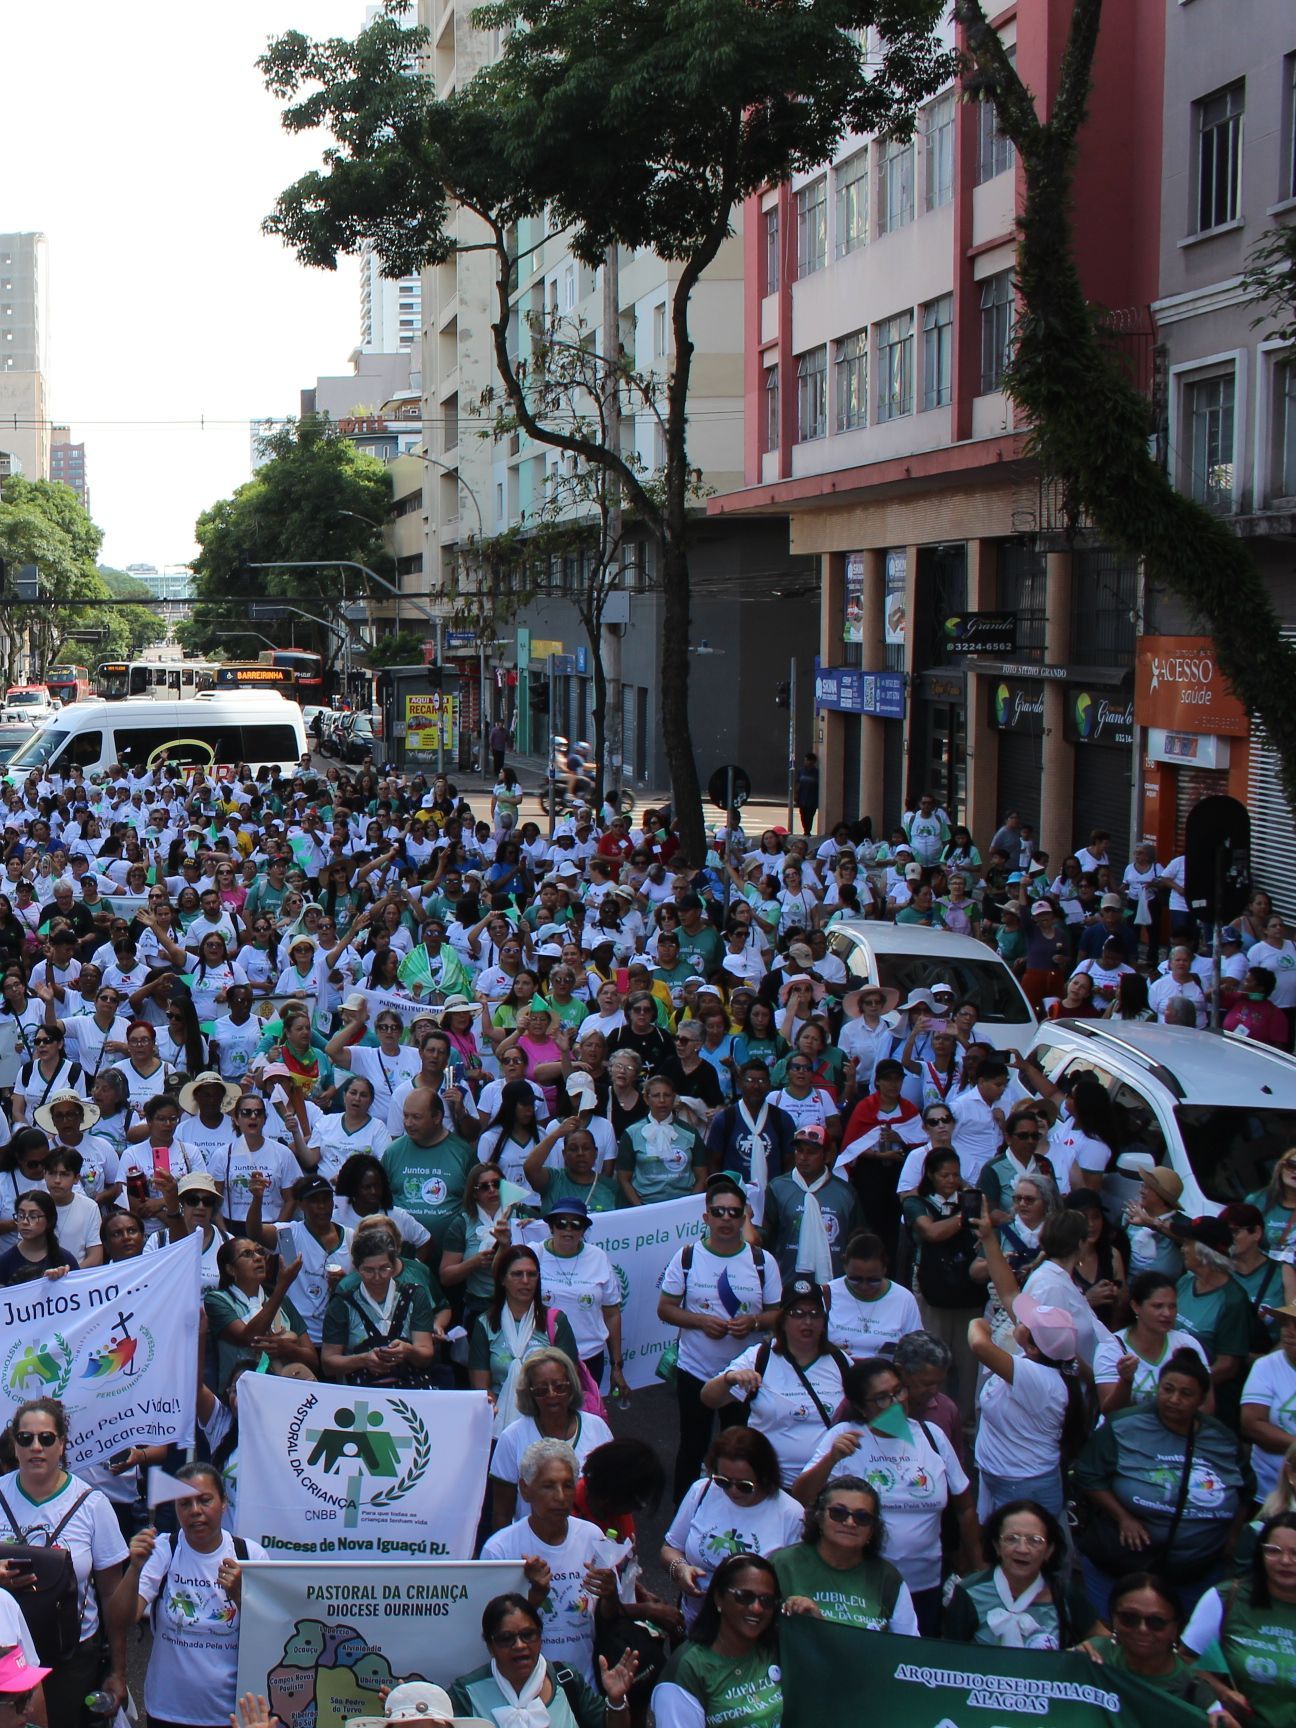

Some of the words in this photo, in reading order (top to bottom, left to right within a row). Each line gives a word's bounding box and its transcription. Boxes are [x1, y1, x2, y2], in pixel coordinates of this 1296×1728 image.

[237, 671, 284, 681] BARREIRINHA
[1040, 667, 1067, 678] GRANDO
[1160, 658, 1213, 683] ACESSO
[1180, 686, 1212, 704] saúde
[409, 704, 449, 715] RECARA
[403, 1167, 430, 1175] Juntos
[590, 1237, 630, 1254] ntos
[635, 1229, 670, 1252] pela
[675, 1219, 709, 1240] Vida
[4, 1292, 82, 1326] Juntos
[89, 1283, 120, 1308] na
[640, 1337, 680, 1357] Umua
[98, 1406, 134, 1431] Pela
[287, 1394, 319, 1457] PASTORAL
[74, 1447, 94, 1463] de
[98, 1421, 177, 1456] Jacarezinho
[290, 1458, 305, 1478] DA
[300, 1476, 357, 1510] CRIANÇA
[305, 1509, 337, 1521] CNBB
[361, 1509, 376, 1517] Para
[261, 1535, 318, 1553] Diocese
[319, 1537, 335, 1552] de
[337, 1536, 376, 1551] Nova
[377, 1535, 427, 1556] Iguaçú
[174, 1573, 212, 1588] Juntos
[306, 1584, 378, 1600] PASTORAL
[382, 1584, 401, 1600] DA
[406, 1584, 469, 1605] CRIANÇA
[812, 1591, 867, 1608] JUBILEU
[326, 1603, 380, 1617] DIOCESE
[383, 1603, 449, 1617] OURINHOS
[161, 1633, 205, 1649] Caminhada
[206, 1641, 223, 1650] Pela
[293, 1645, 319, 1655] Ocauçu
[269, 1675, 295, 1686] Campos
[295, 1673, 315, 1682] Novas
[279, 1682, 305, 1693] Paulista
[895, 1664, 1026, 1693] ARQUIDIOCESE
[1026, 1679, 1052, 1696] DE
[1052, 1683, 1120, 1712] MACEIÓ
[330, 1696, 343, 1706] São
[344, 1698, 365, 1706] Pedro
[342, 1705, 362, 1714] Turvo
[967, 1689, 1049, 1714] ALAGOAS
[706, 1706, 755, 1726] PASTORAL
